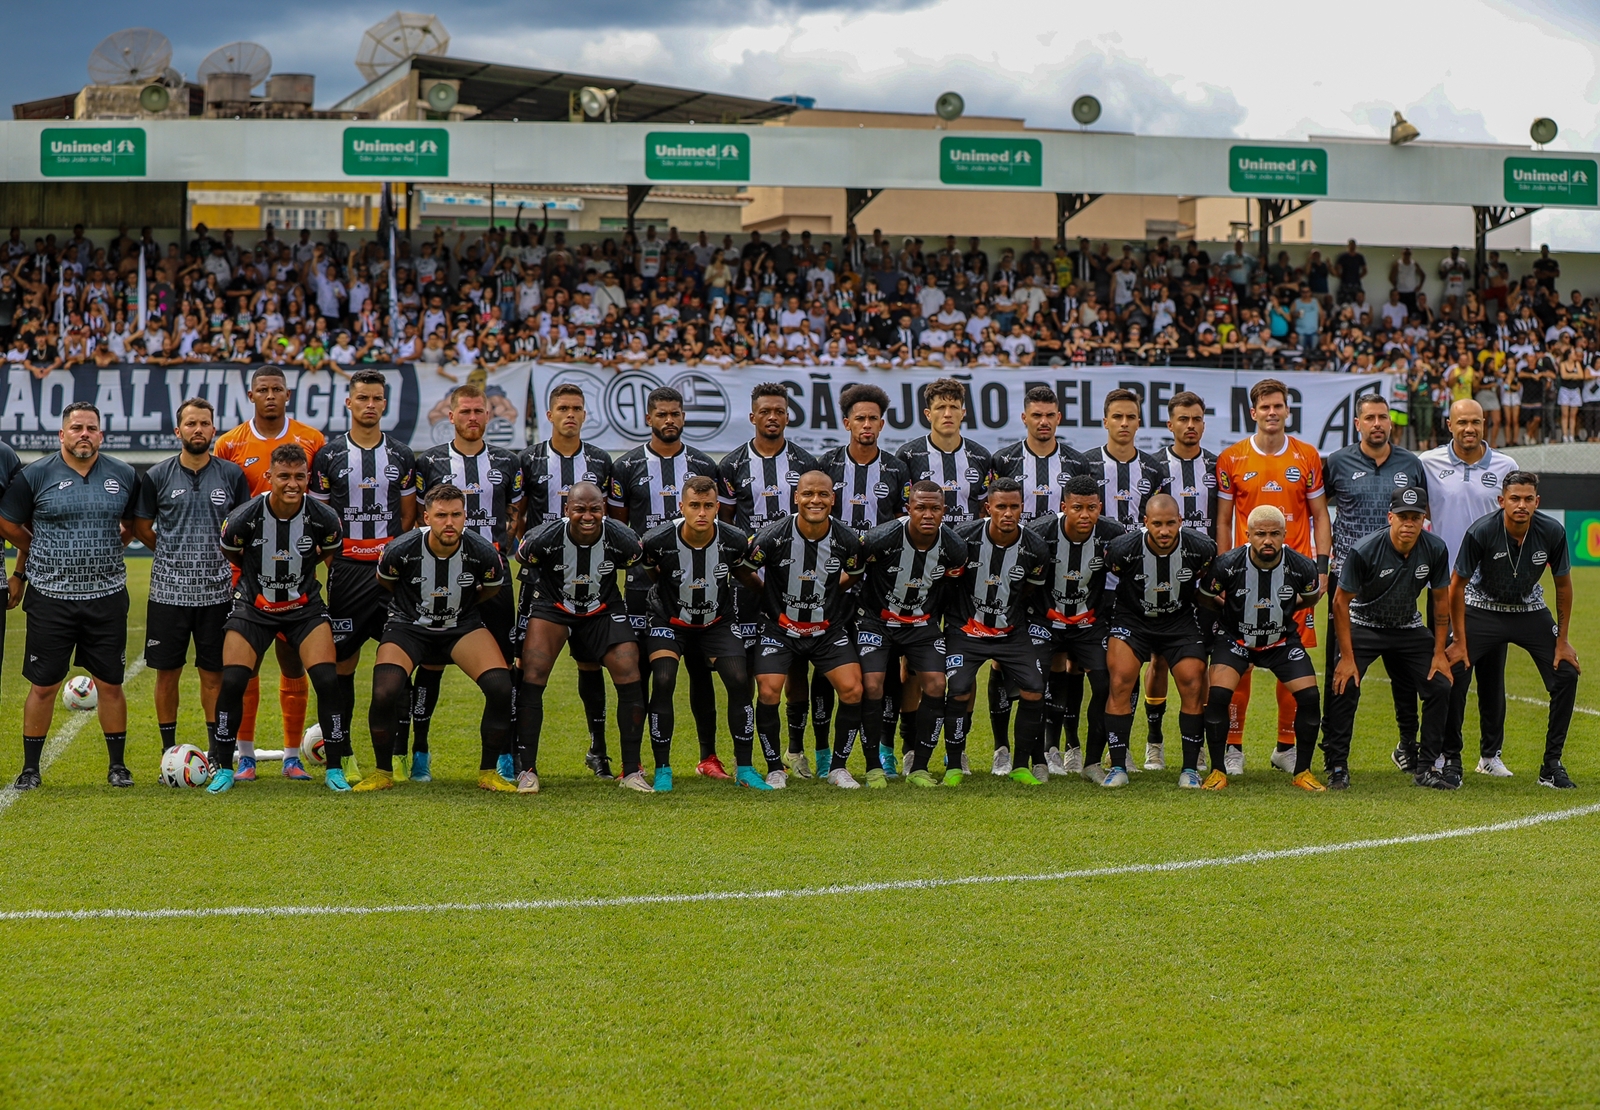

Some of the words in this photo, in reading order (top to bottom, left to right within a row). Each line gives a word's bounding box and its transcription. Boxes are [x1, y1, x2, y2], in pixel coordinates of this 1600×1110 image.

[51, 140, 112, 152] Unimed
[354, 140, 414, 152] Unimed
[656, 145, 716, 157] Unimed
[950, 150, 1009, 162] Unimed
[1239, 158, 1296, 171] Unimed
[1514, 169, 1567, 182] Unimed
[778, 373, 858, 430] SÃ
[87, 512, 108, 520] CLUB
[355, 512, 370, 521] JOÃO
[942, 514, 953, 522] OÃO
[464, 518, 476, 526] OÃO
[1181, 519, 1192, 527] OÃO
[78, 531, 98, 539] CLUB
[73, 539, 108, 548] ATHLETIC
[54, 548, 92, 557] ATHLETIC
[64, 558, 86, 566] CLUB
[57, 566, 96, 574] ATHLETIC
[68, 574, 89, 583] CLUB
[178, 577, 196, 585] CLUB
[73, 582, 94, 591] CLUB
[1509, 604, 1528, 612] CLUB
[860, 634, 880, 644] AMG
